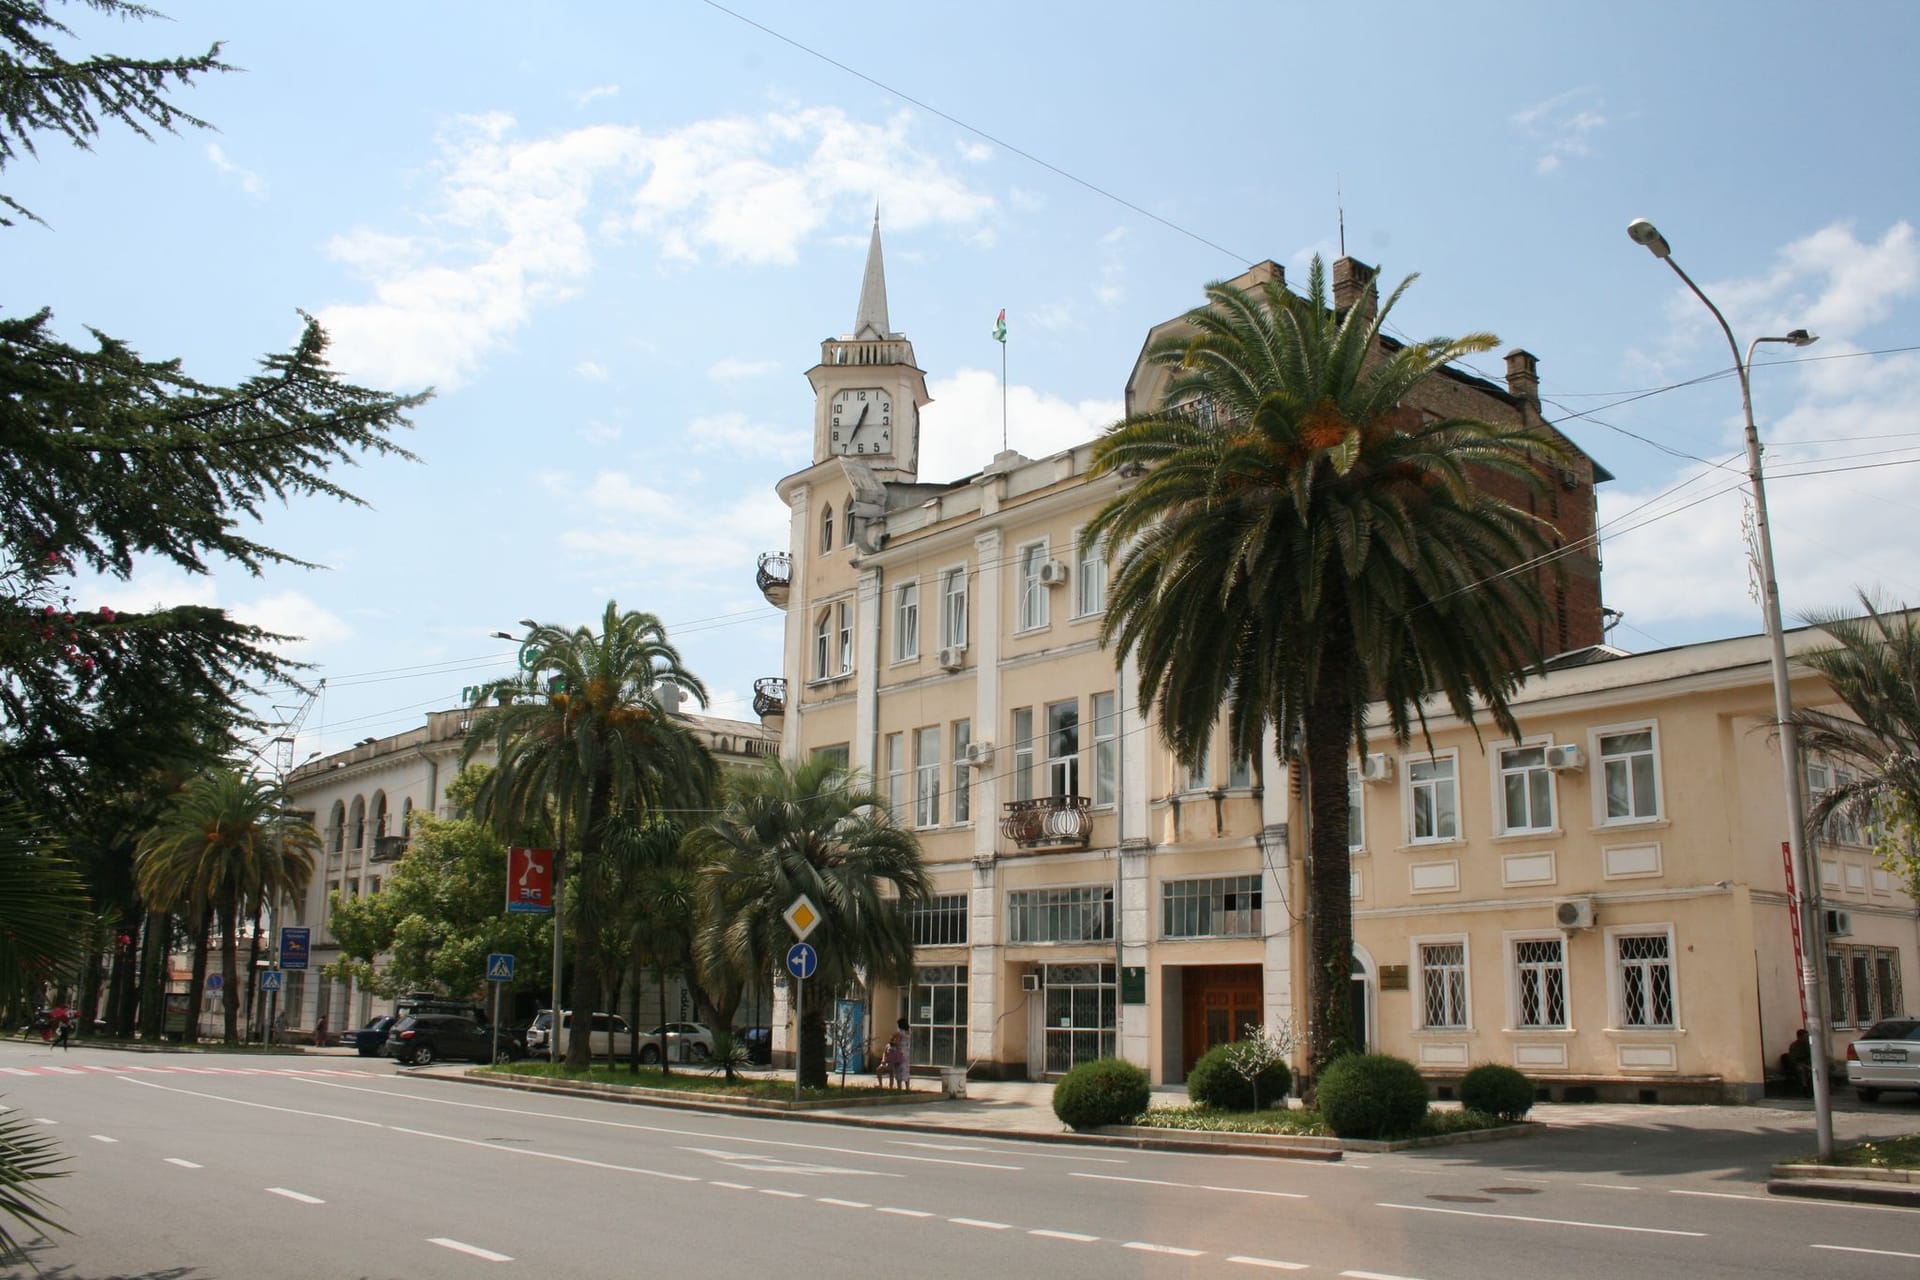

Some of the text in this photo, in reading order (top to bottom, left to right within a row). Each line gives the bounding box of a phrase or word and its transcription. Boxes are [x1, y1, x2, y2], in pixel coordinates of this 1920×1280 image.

[843, 392, 848, 400] 11
[857, 392, 866, 401] 12
[834, 404, 842, 414] 10
[883, 403, 889, 412] 2
[833, 418, 839, 427] 9
[883, 416, 889, 426] 3
[833, 431, 839, 441] 8
[883, 431, 889, 440] 4
[842, 444, 848, 453] 7
[858, 444, 863, 453] 6
[874, 443, 880, 452] 5
[520, 888, 542, 899] 3G
